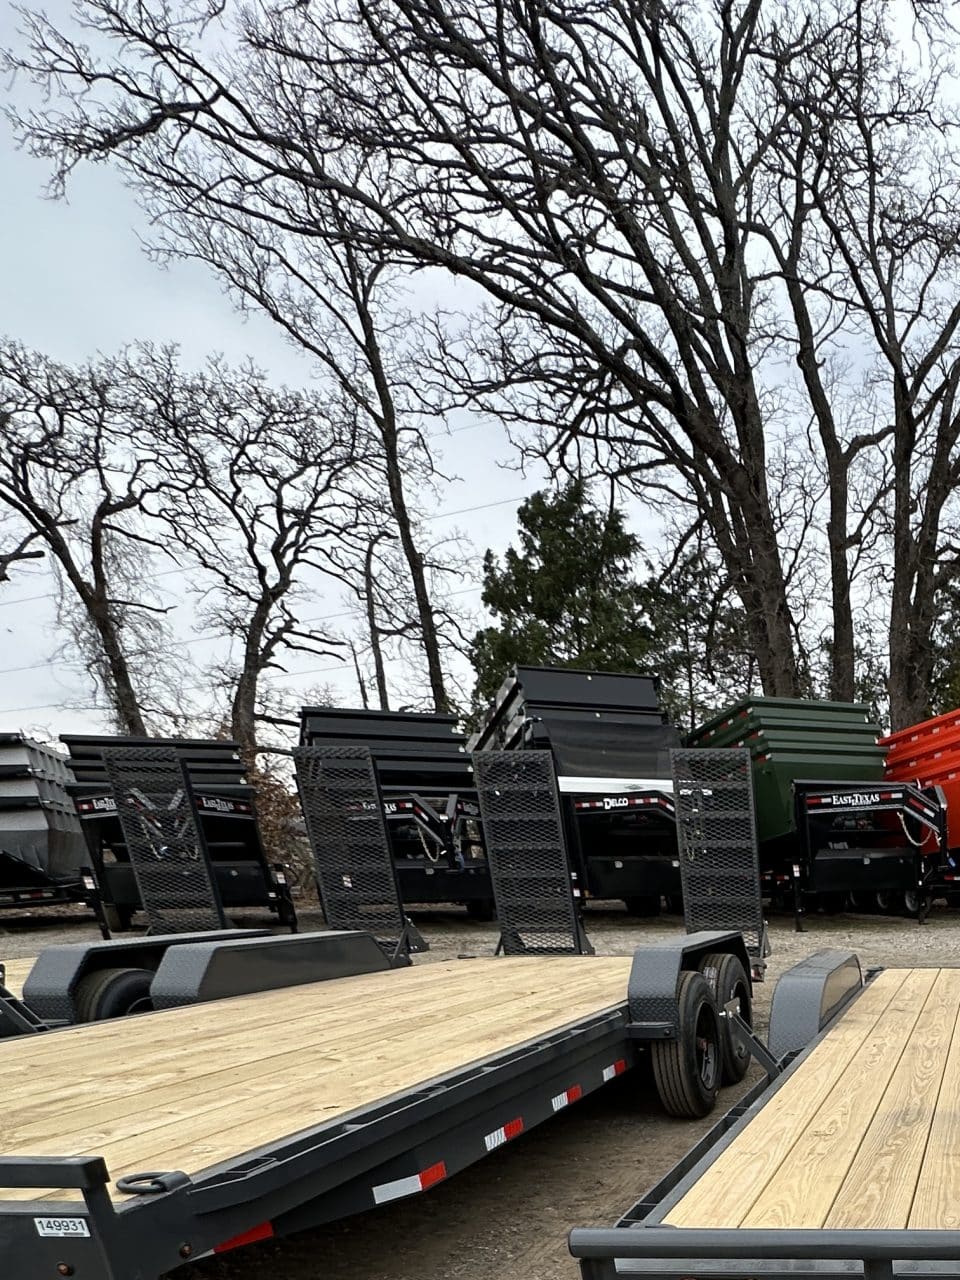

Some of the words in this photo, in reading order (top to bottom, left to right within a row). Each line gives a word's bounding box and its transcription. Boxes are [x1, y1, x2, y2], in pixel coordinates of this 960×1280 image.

[603, 797, 629, 810] DELCO
[832, 795, 853, 805] EAST
[852, 793, 880, 803] TEXAS
[37, 1220, 86, 1231] 149931
